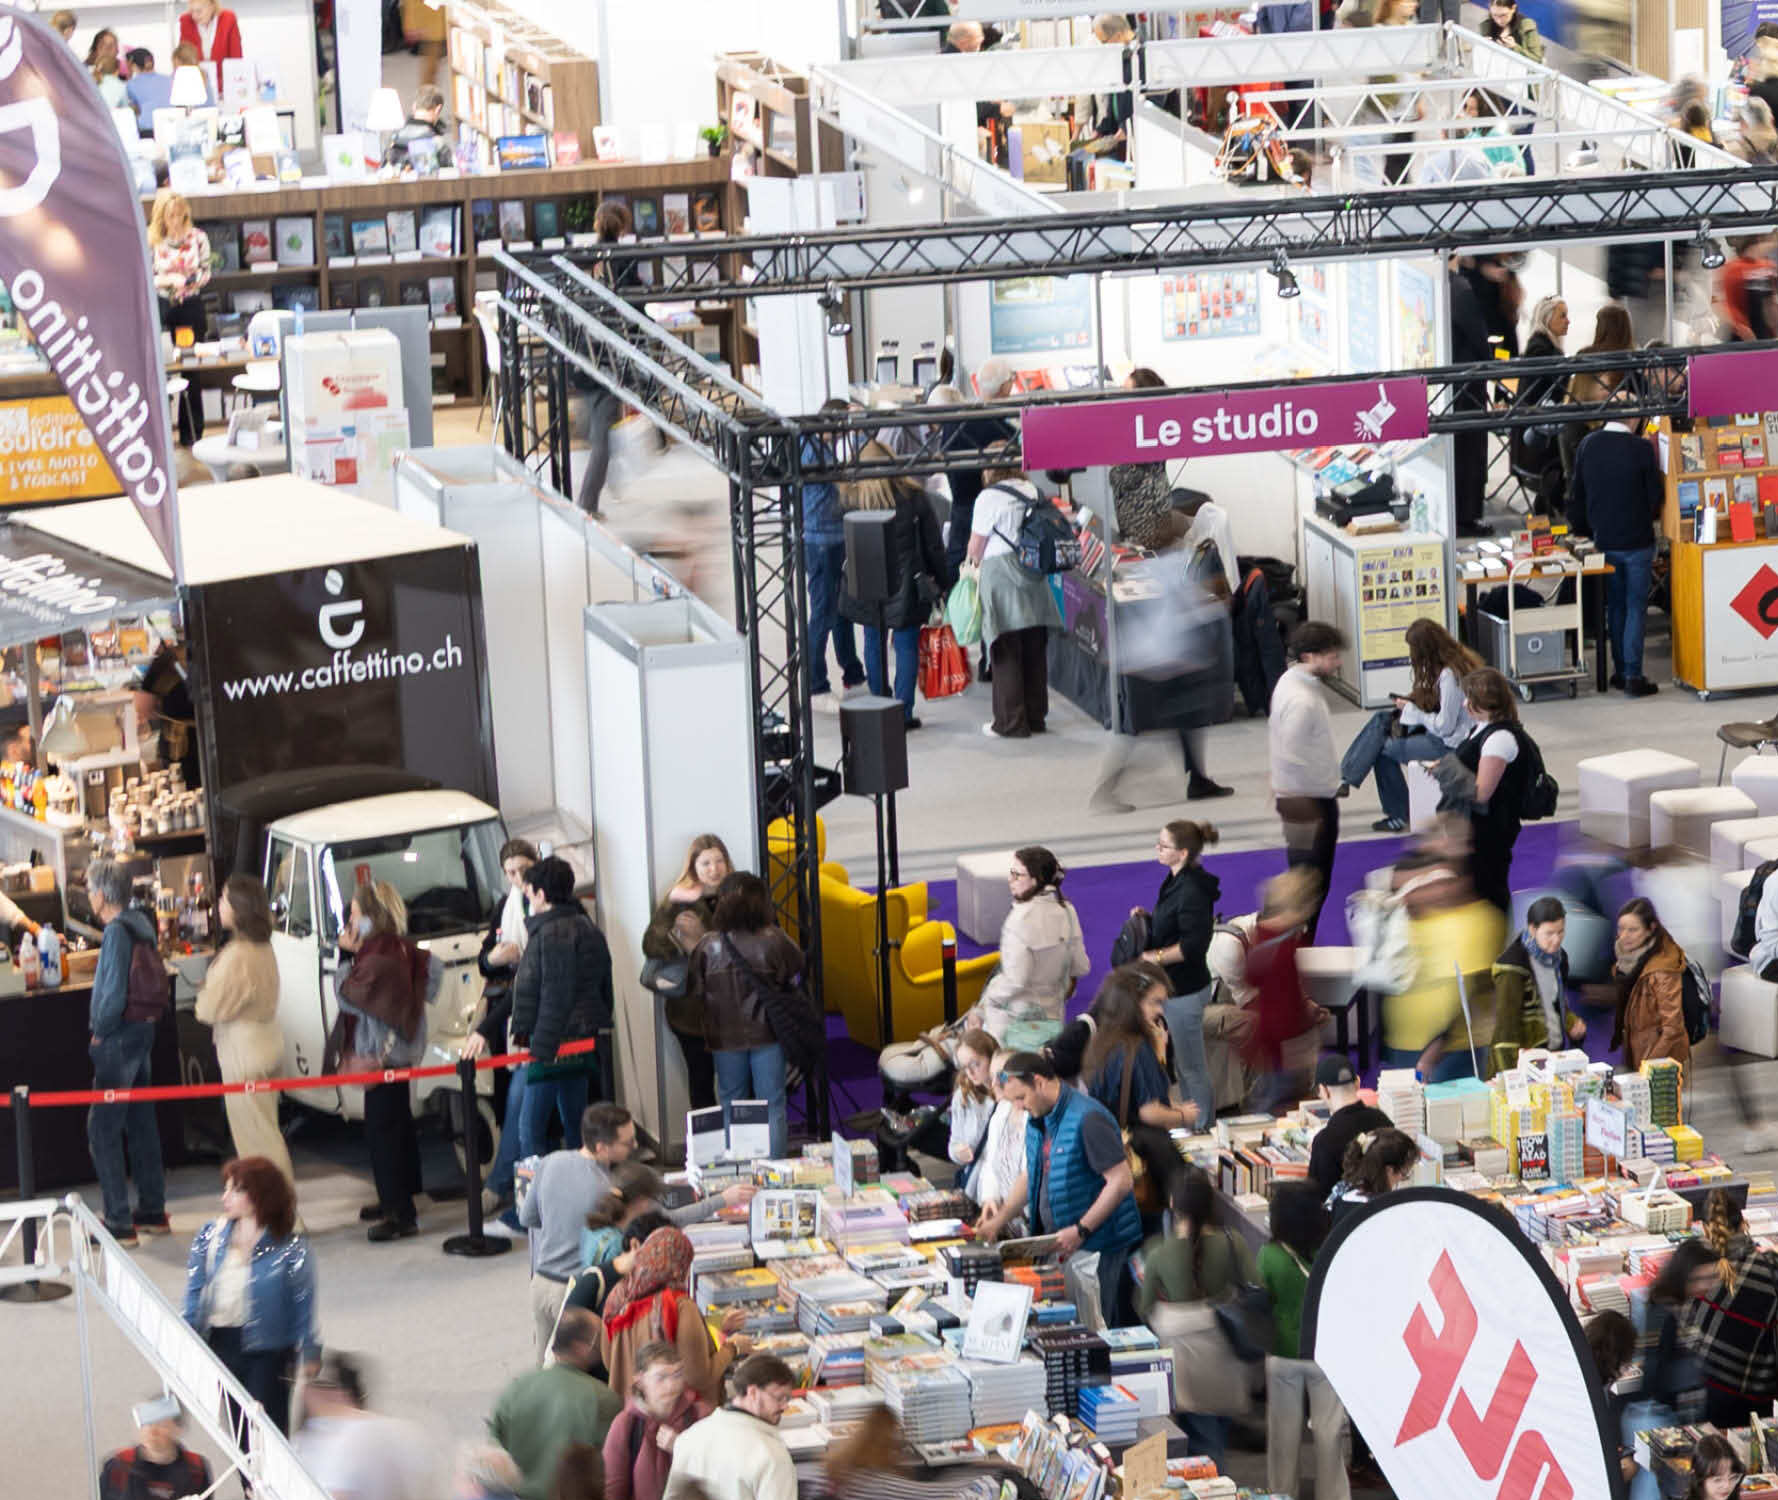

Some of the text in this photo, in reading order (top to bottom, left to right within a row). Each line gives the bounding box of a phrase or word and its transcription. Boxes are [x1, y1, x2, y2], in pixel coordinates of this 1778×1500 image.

[1135, 402, 1319, 449] Le studio
[223, 633, 463, 701] www.caffettino.ch
[1519, 1135, 1544, 1146] HOW
[1520, 1145, 1533, 1154] TO
